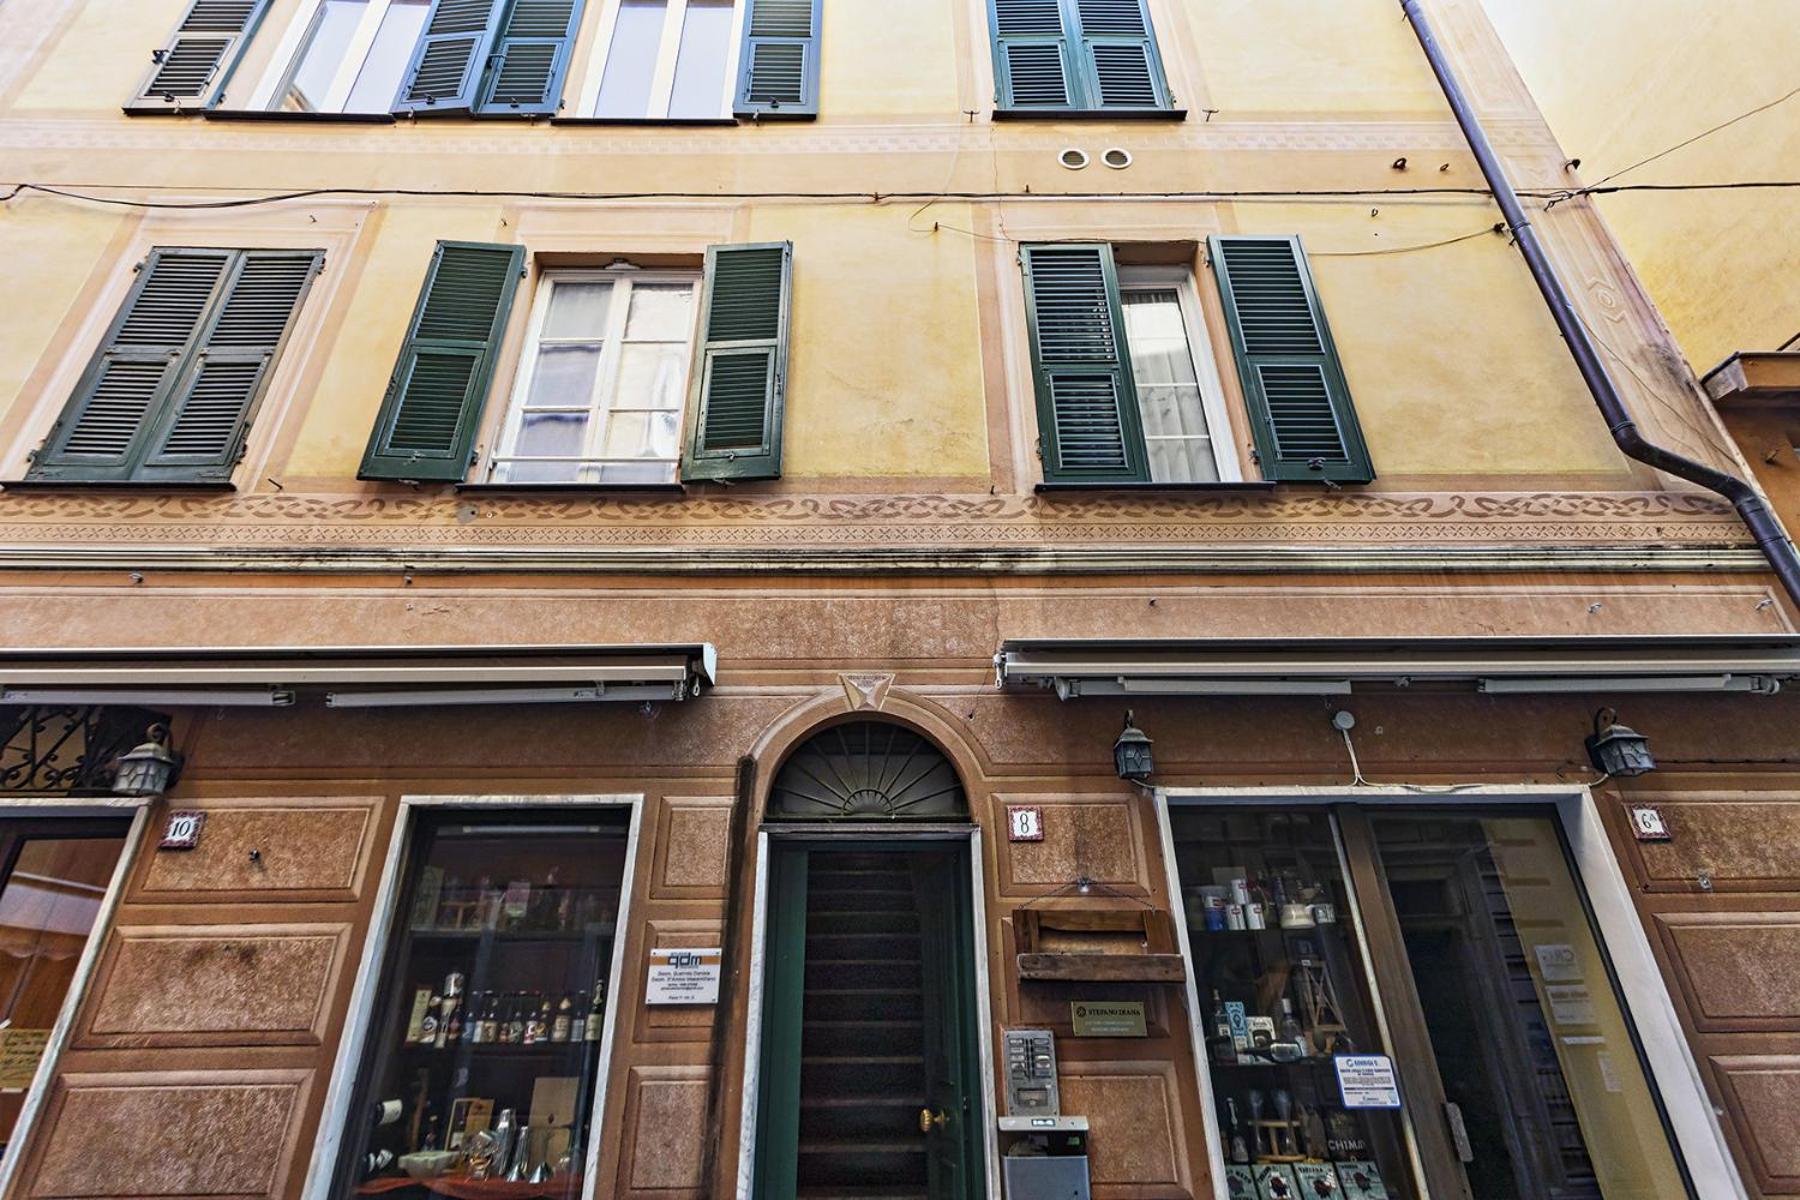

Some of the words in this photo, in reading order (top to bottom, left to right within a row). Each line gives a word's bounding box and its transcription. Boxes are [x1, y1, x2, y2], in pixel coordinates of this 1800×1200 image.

[172, 820, 190, 837] 10
[1020, 814, 1029, 834] 8
[1641, 813, 1658, 829] 6A
